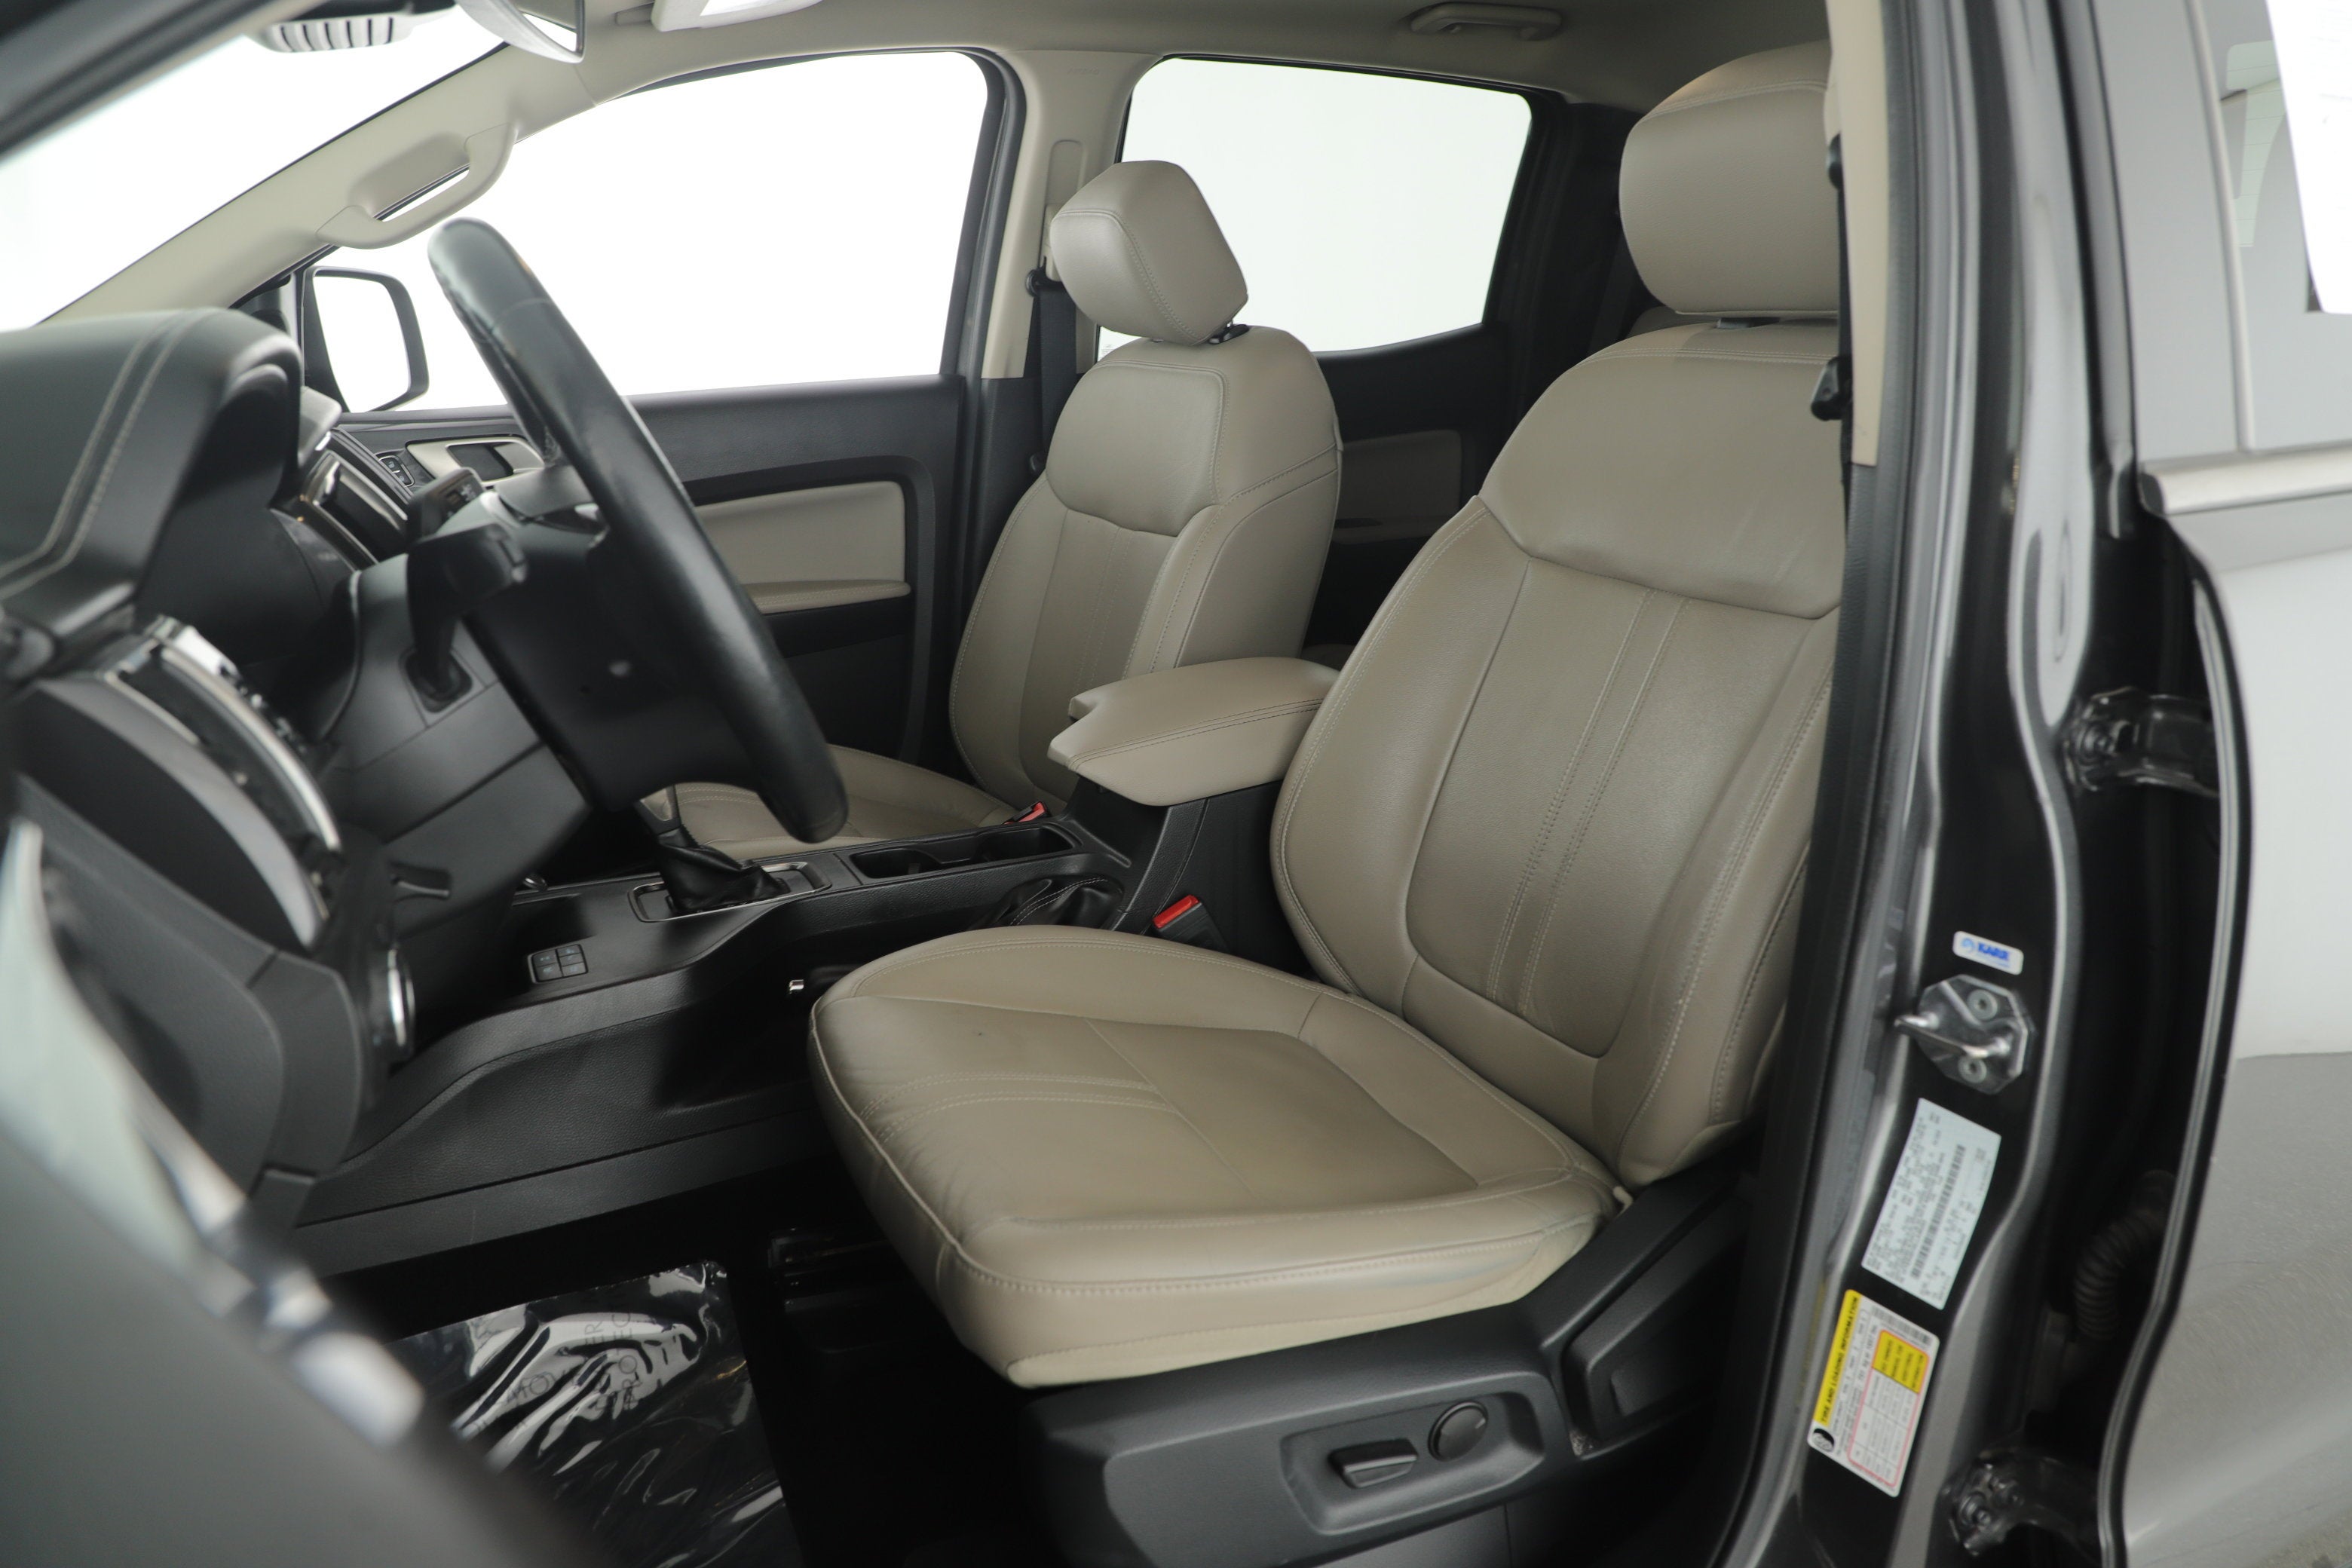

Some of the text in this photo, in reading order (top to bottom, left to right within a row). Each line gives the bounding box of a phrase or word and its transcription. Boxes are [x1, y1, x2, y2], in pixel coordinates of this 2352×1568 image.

[1821, 1405, 1830, 1423] TIRE
[1826, 1387, 1834, 1404] AND
[1830, 1351, 1843, 1386] LOADING
[1841, 1295, 1858, 1350] INFORMATION
